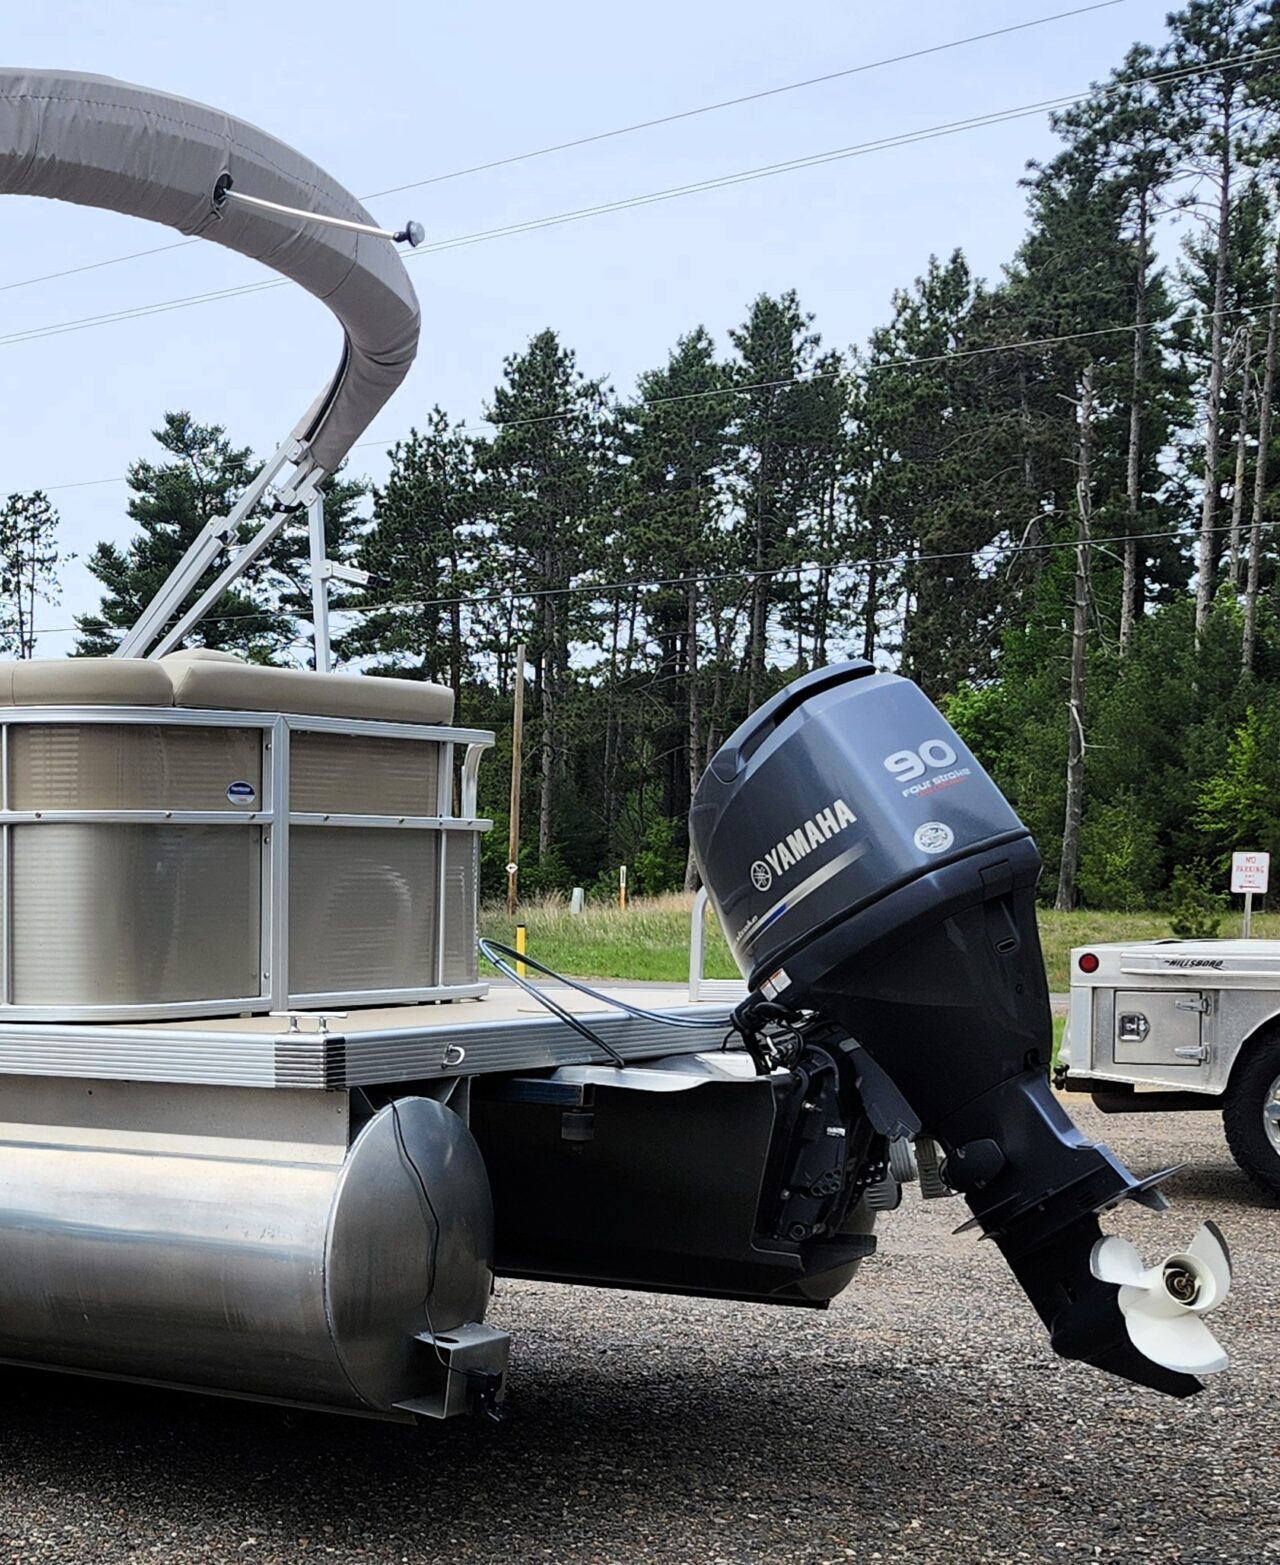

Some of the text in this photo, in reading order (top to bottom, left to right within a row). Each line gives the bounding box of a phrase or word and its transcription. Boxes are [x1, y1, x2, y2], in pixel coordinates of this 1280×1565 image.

[883, 739, 957, 783] 90
[764, 798, 858, 877] YAMAHA
[1245, 856, 1257, 864] NO
[1235, 865, 1265, 874] PARKING
[1166, 959, 1225, 970] HILLSBORO
